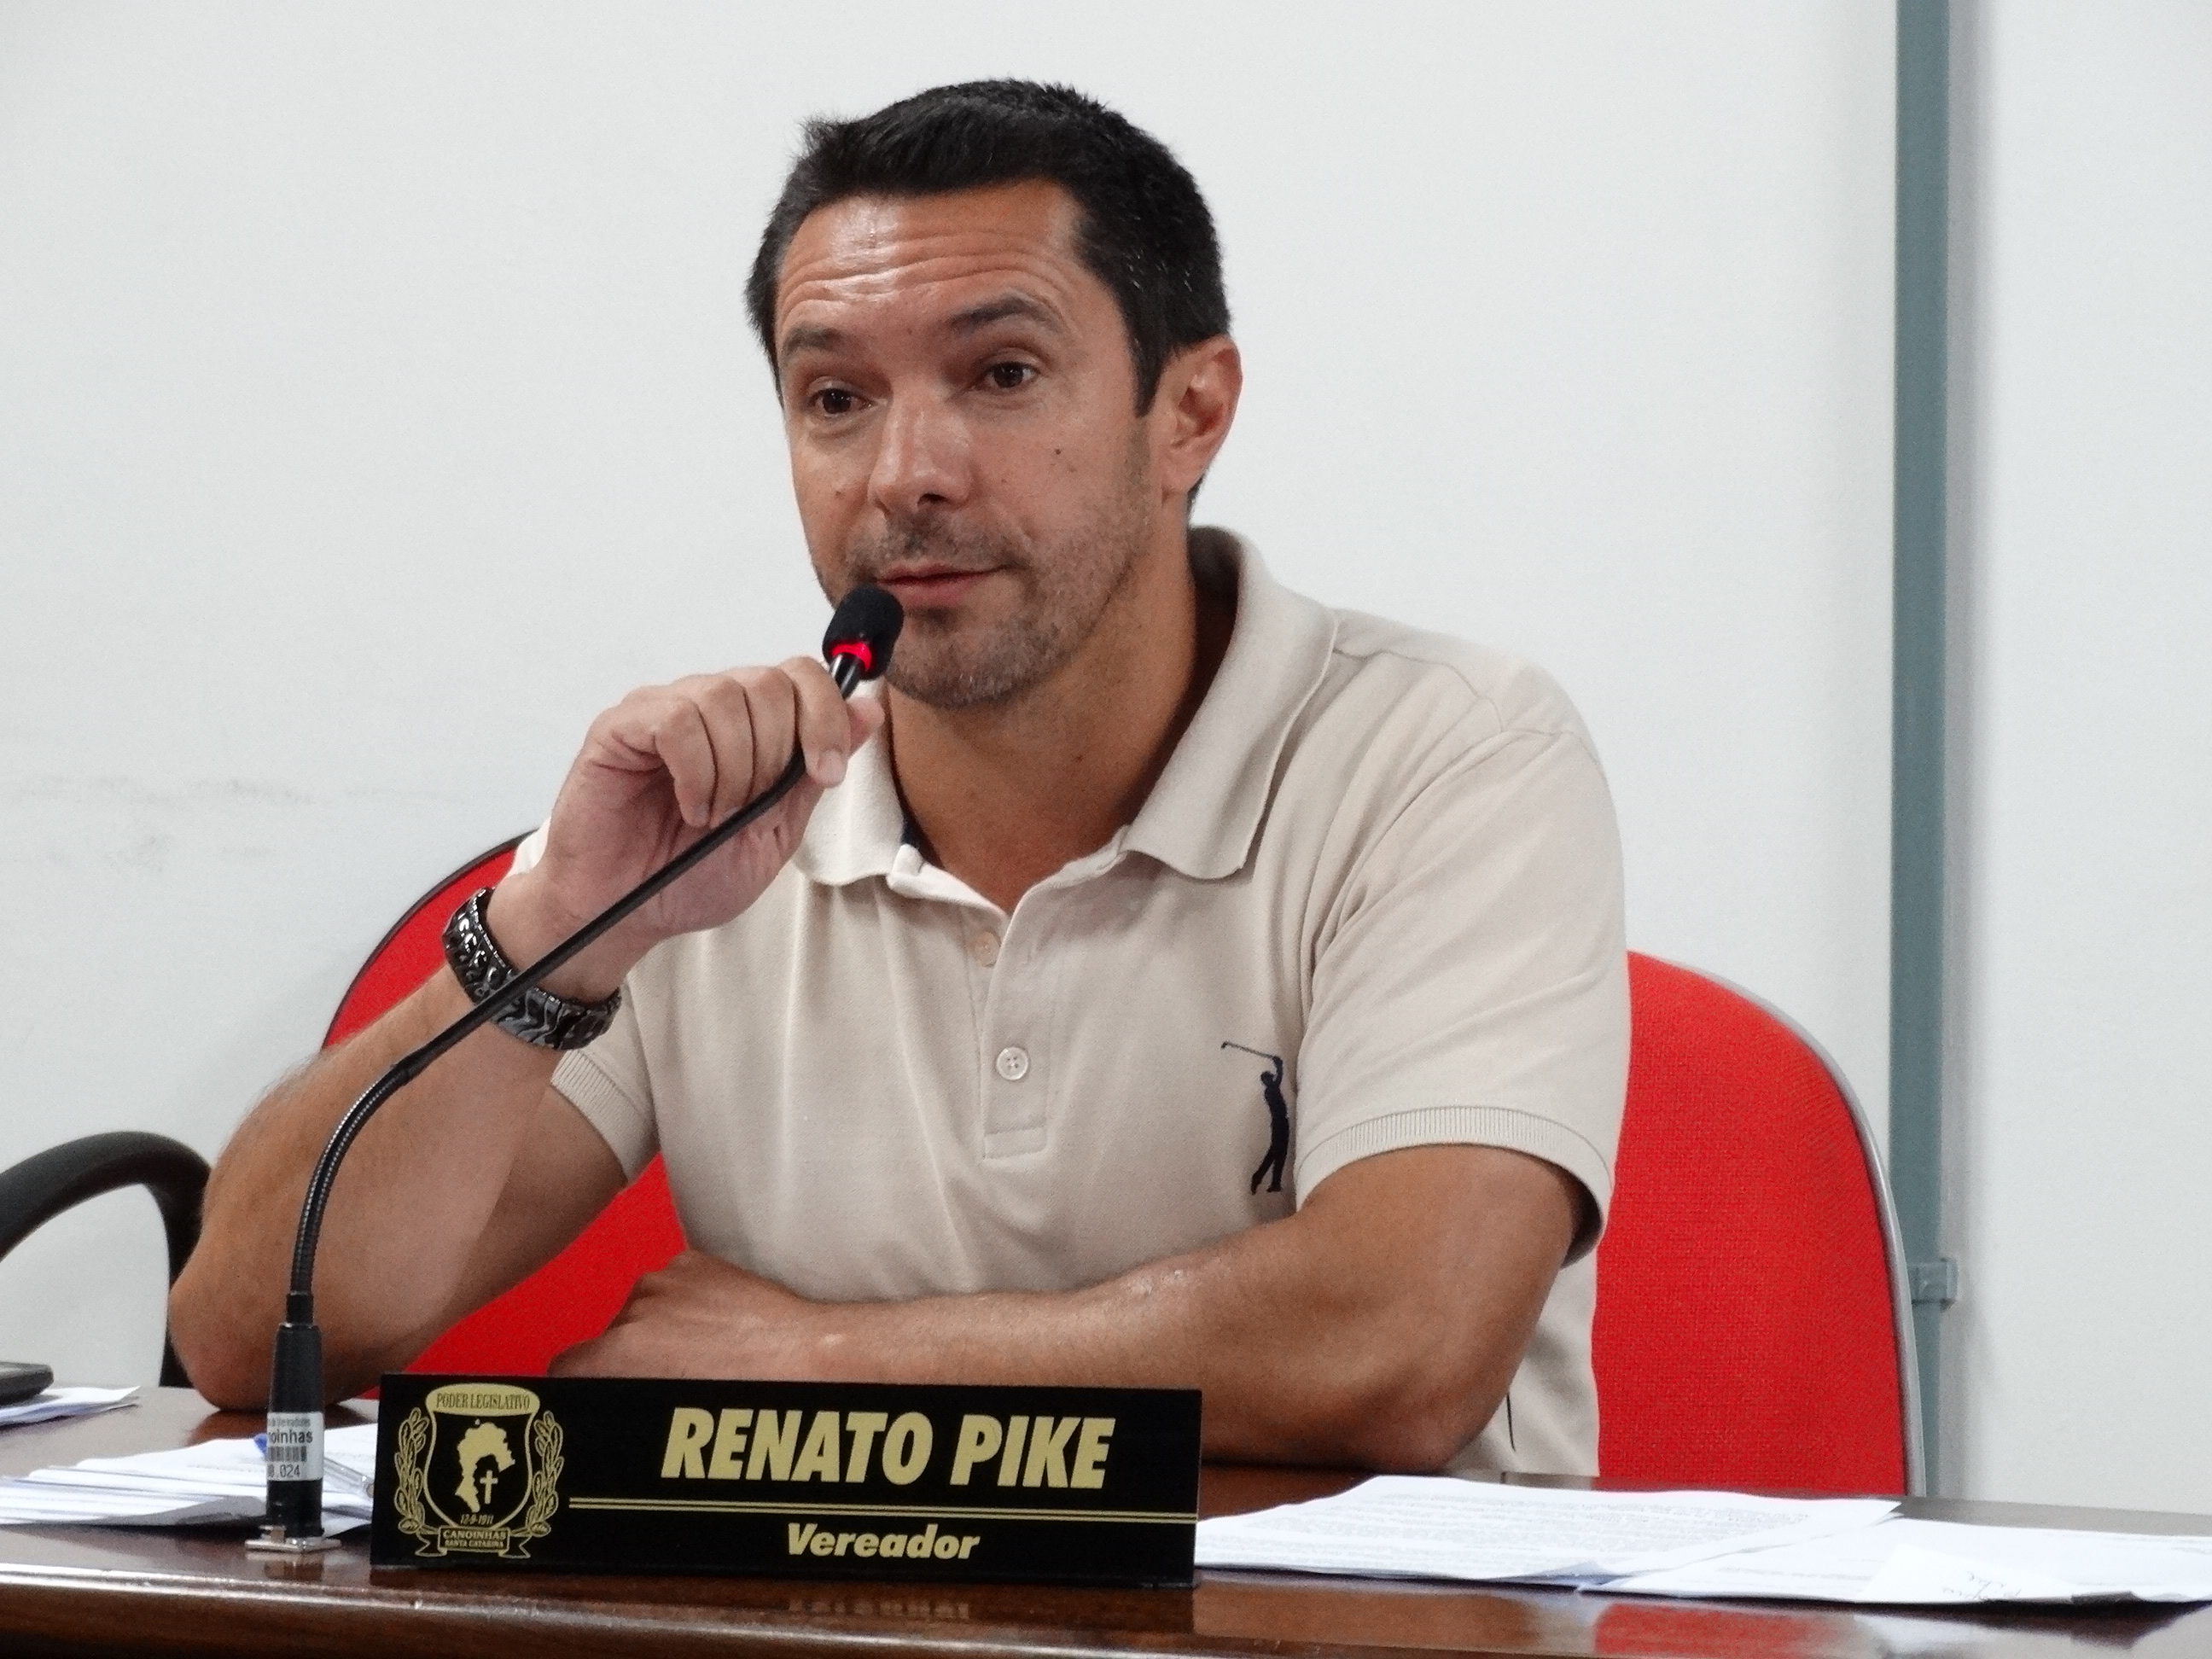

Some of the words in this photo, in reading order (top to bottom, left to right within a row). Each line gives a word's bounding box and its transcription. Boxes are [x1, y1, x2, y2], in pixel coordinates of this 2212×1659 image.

[436, 1392, 469, 1409] PODER
[470, 1393, 531, 1411] LEGISLATIVO
[661, 1406, 934, 1486] RENATO
[949, 1413, 1116, 1489] PIKE
[442, 1529, 507, 1540] CANOINHAS
[786, 1522, 981, 1560] Vereador
